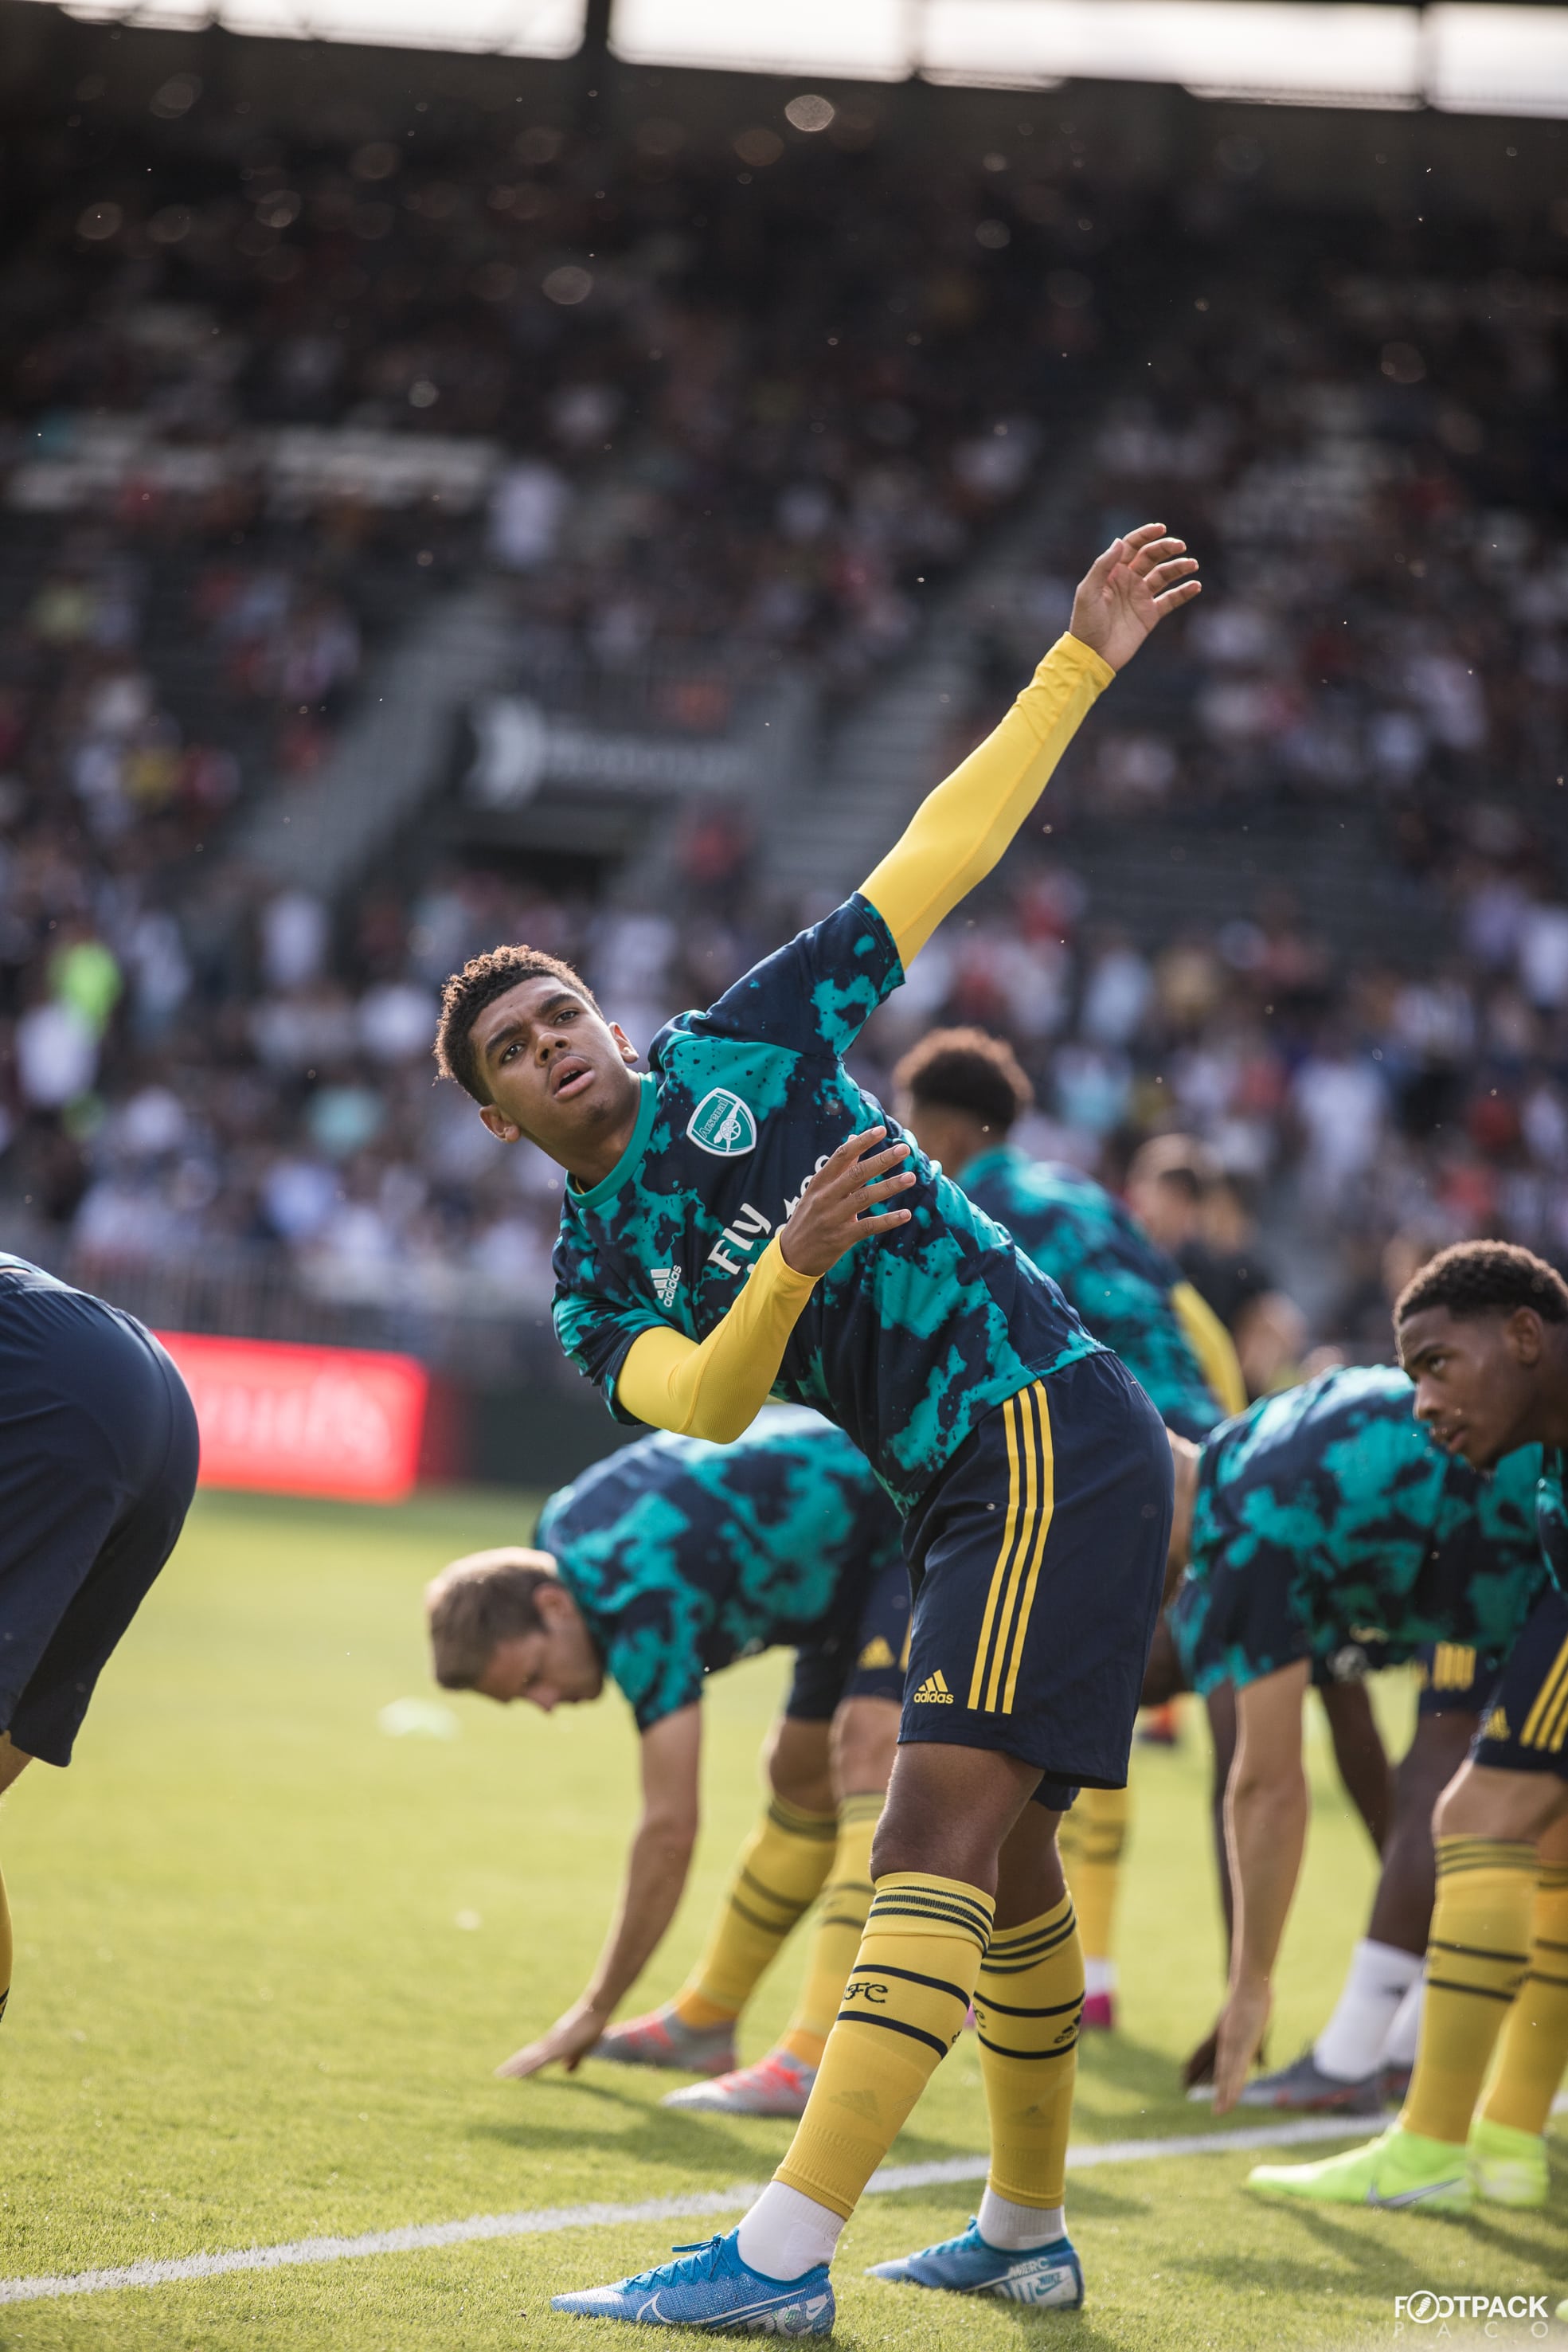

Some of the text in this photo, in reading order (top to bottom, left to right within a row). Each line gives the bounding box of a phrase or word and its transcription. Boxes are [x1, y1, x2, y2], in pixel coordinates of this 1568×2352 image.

[698, 1098, 729, 1139] Arsenal
[707, 1203, 772, 1274] Fly
[663, 1264, 682, 1308] adidas
[913, 1691, 954, 1704] adidas
